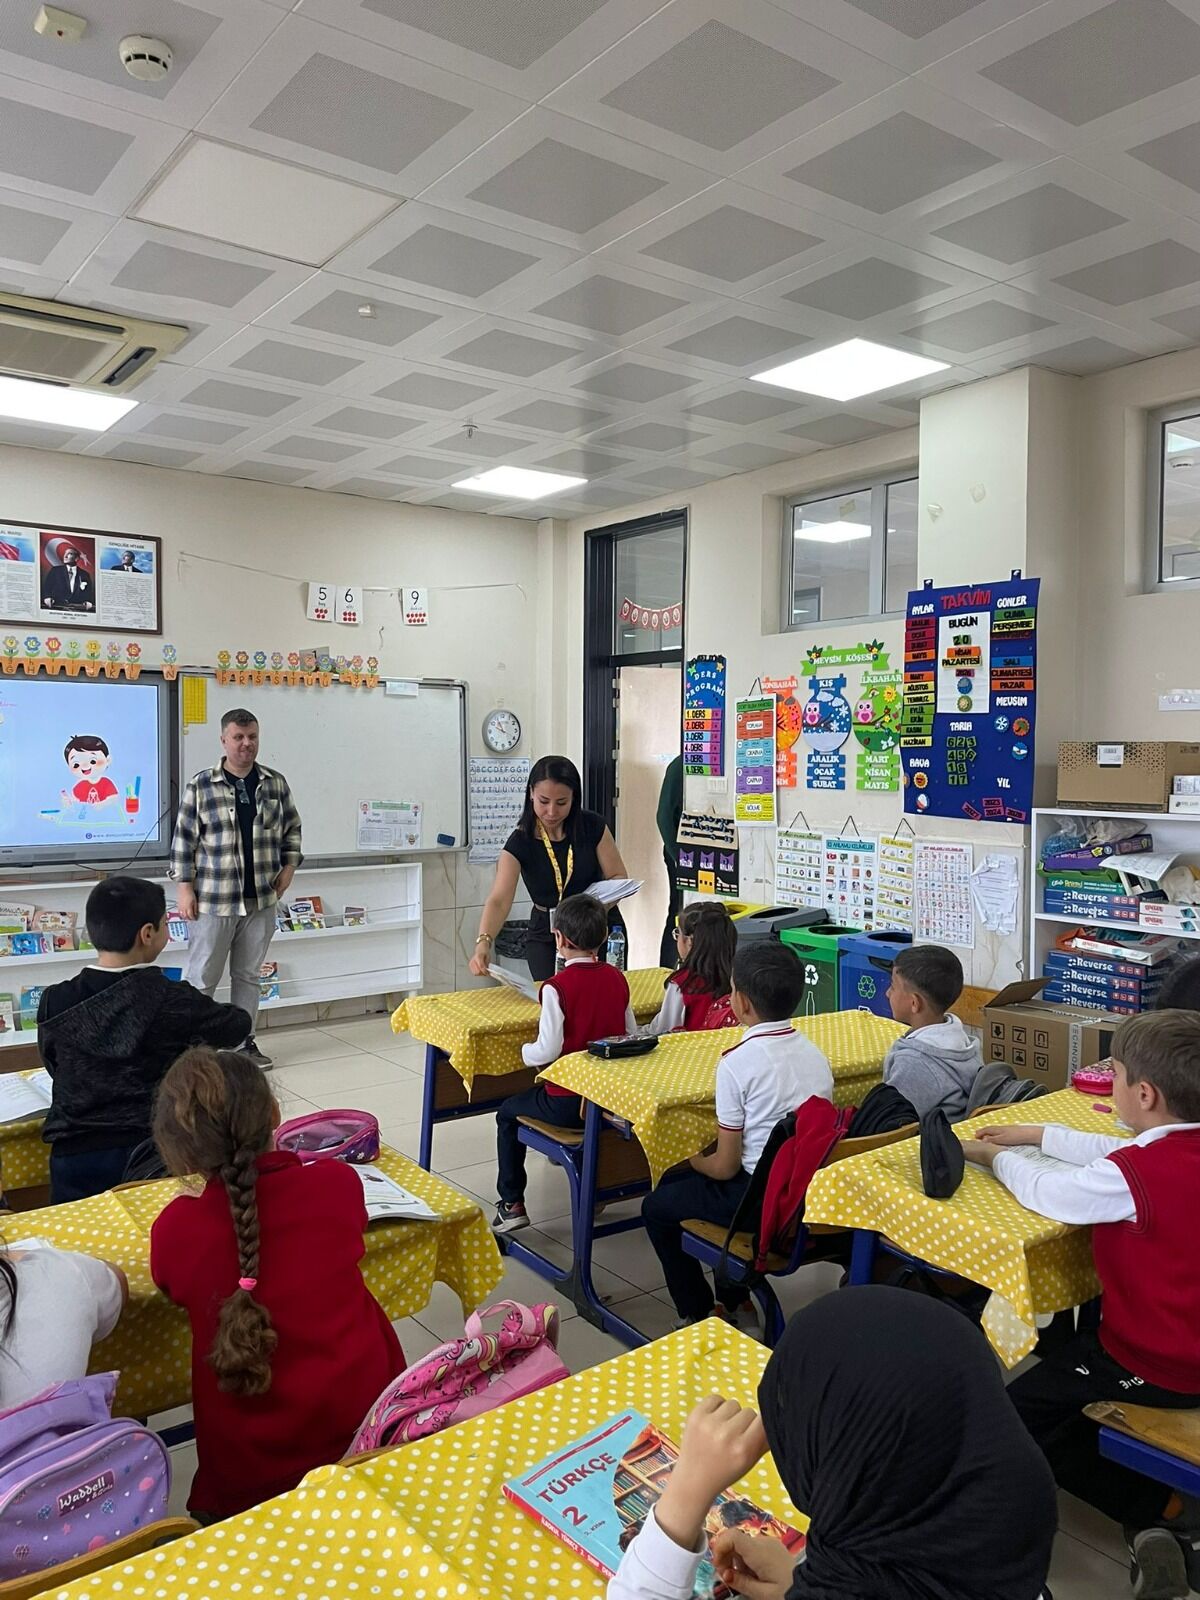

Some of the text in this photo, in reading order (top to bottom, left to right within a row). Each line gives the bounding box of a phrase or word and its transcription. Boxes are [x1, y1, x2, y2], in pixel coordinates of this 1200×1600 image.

[318, 587, 327, 600] 5
[344, 588, 354, 602] 6
[411, 590, 420, 605] 9
[941, 589, 992, 610] TAKVİM
[912, 604, 934, 616] AYLAR
[948, 616, 978, 628] BUGÜN
[994, 620, 1032, 632] PERŞEMBE
[953, 635, 969, 646] 20
[814, 654, 842, 664] MEVSİM
[942, 656, 980, 668] PAZARTESİ
[694, 670, 716, 680] DERS
[992, 666, 1032, 677] CUMARTESİ
[860, 674, 902, 684] İLKBAHAR
[1000, 681, 1026, 689] PAZAR
[686, 682, 725, 700] PROGRAMI
[810, 754, 840, 763] ARALIK
[865, 754, 890, 763] MART
[814, 768, 836, 776] OCAK
[864, 767, 891, 776] NİSAN
[864, 780, 890, 790] MAYIS
[996, 778, 1010, 788] YIL
[1072, 890, 1108, 903] Reverse
[1076, 957, 1114, 972] Reverse
[1070, 970, 1108, 984] Reverse
[1070, 983, 1108, 998] Reverse
[1070, 996, 1108, 1012] Reverse
[536, 1452, 618, 1503] TÜRKÇE
[60, 1476, 106, 1510] Waddell
[562, 1506, 588, 1526] 2
[560, 1532, 578, 1552] TÜRKÇE
